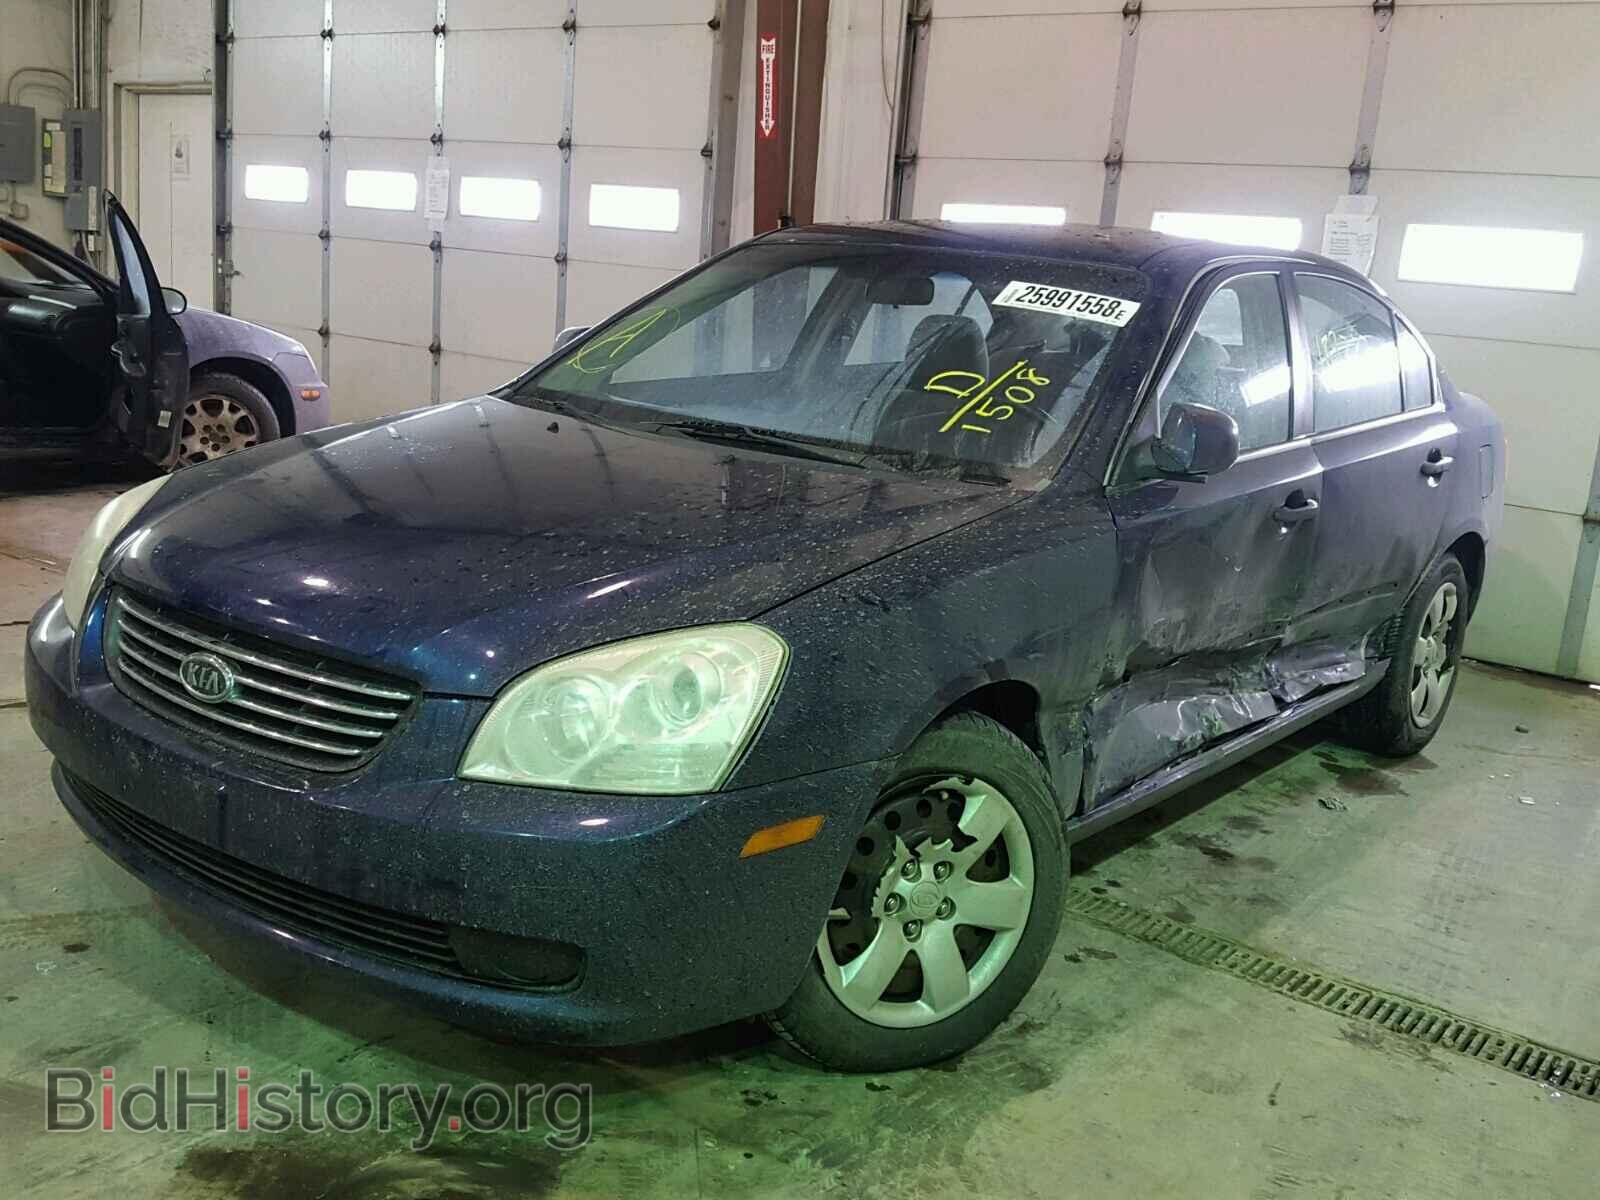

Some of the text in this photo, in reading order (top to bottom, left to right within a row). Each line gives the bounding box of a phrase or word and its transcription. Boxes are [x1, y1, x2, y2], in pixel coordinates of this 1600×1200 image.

[762, 44, 774, 54] FIRE
[1015, 285, 1122, 318] 25991558
[186, 662, 219, 694] KIA
